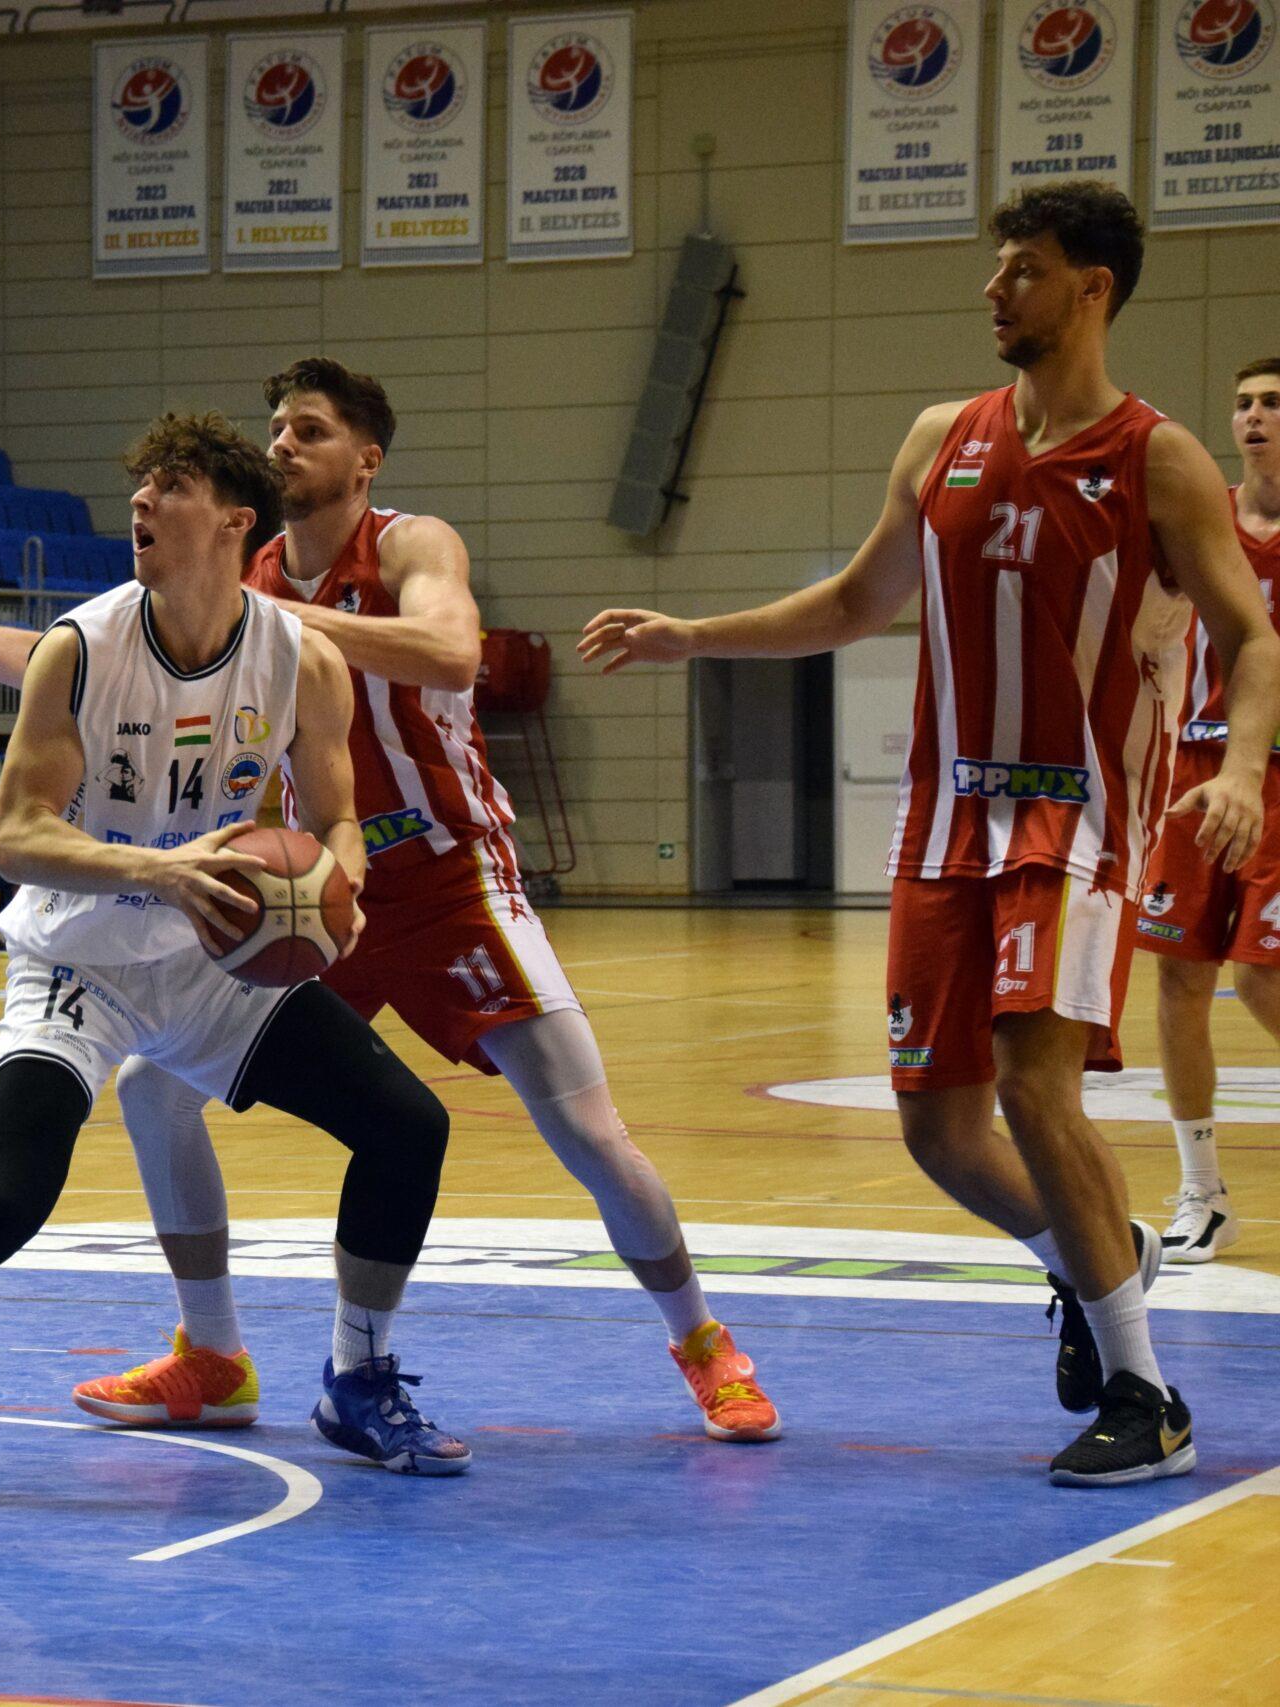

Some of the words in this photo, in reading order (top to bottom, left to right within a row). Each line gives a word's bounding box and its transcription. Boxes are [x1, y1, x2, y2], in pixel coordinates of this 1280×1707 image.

[1195, 100, 1252, 113] CSAPATA
[1204, 122, 1242, 142] 2018
[1046, 134, 1083, 152] 2019
[1011, 159, 1072, 176] MAGYAR
[1077, 155, 1117, 170] KUPA
[1164, 149, 1212, 166] MAGYAR
[859, 167, 902, 183] MAGYAR
[1187, 168, 1280, 194] HELYEZÉS
[377, 195, 431, 210] MAGYAR
[434, 193, 469, 207] KUPA
[522, 189, 578, 204] MAGYAR
[582, 186, 617, 201] KUPA
[108, 207, 158, 222] MAGYAR
[162, 205, 195, 219] KUPA
[235, 200, 275, 214] MAGYAR
[390, 215, 469, 237] HELYEZÉS
[540, 209, 621, 232] HELYEZÉS
[252, 221, 328, 243] HELYEZÉS
[981, 502, 1044, 563] 21
[117, 722, 151, 736] JAKO
[168, 758, 204, 814] 14
[447, 943, 505, 1002] 11
[44, 978, 87, 1031] 14
